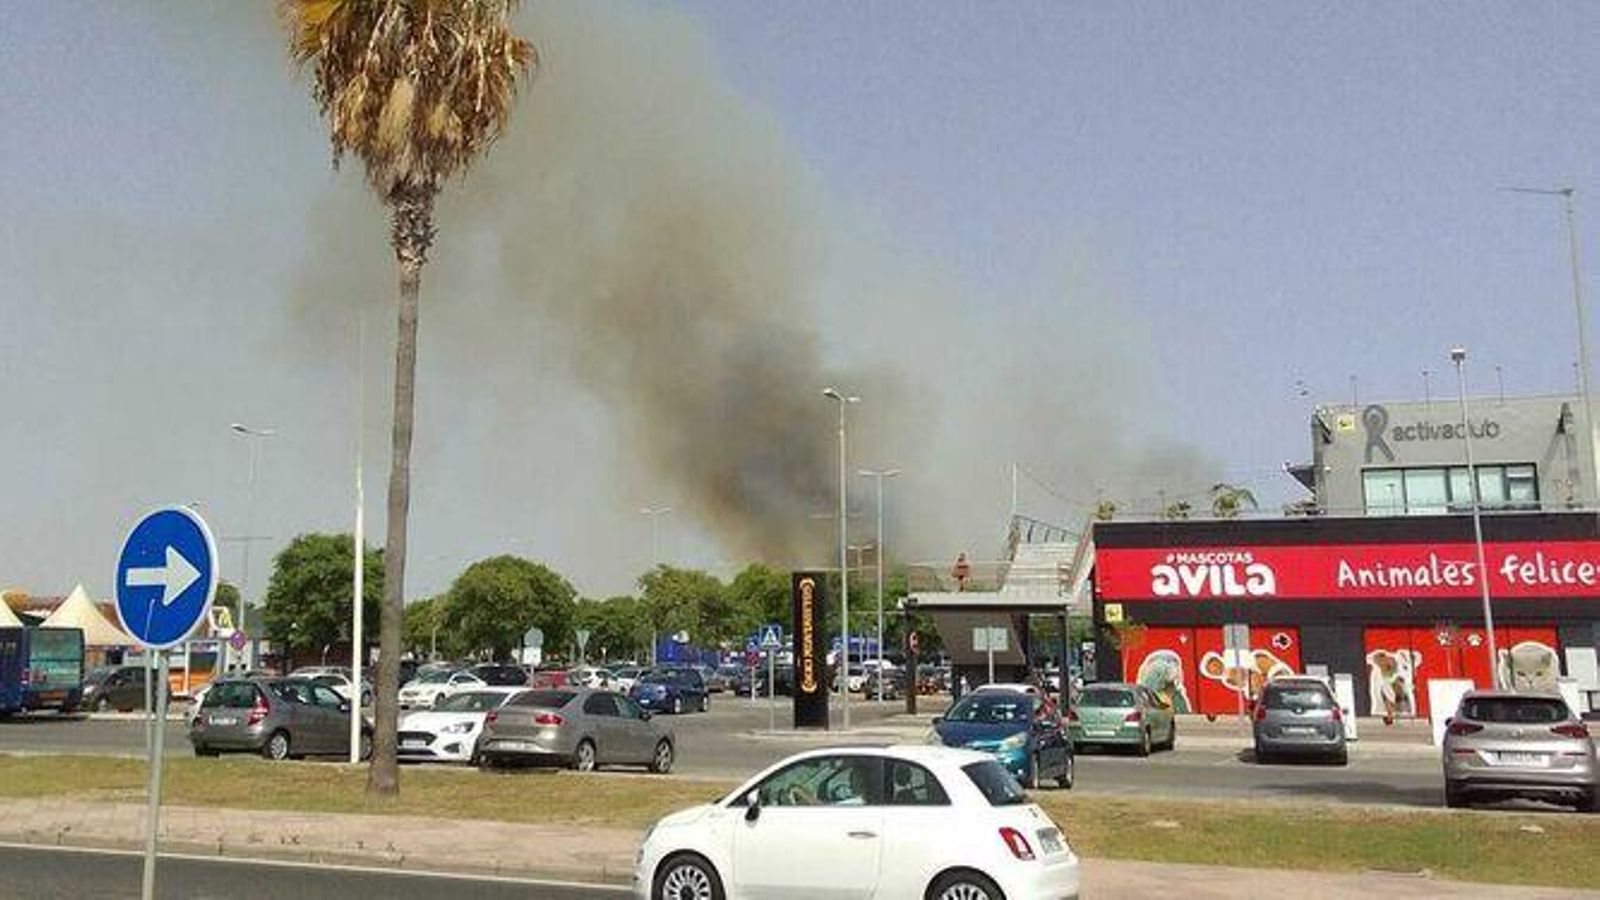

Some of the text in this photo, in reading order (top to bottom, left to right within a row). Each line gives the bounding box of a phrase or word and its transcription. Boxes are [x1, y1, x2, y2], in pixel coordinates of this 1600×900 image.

[1392, 417, 1500, 441] activaclub
[1176, 552, 1253, 565] MASCOTAS
[1337, 550, 1600, 588] Animales felice
